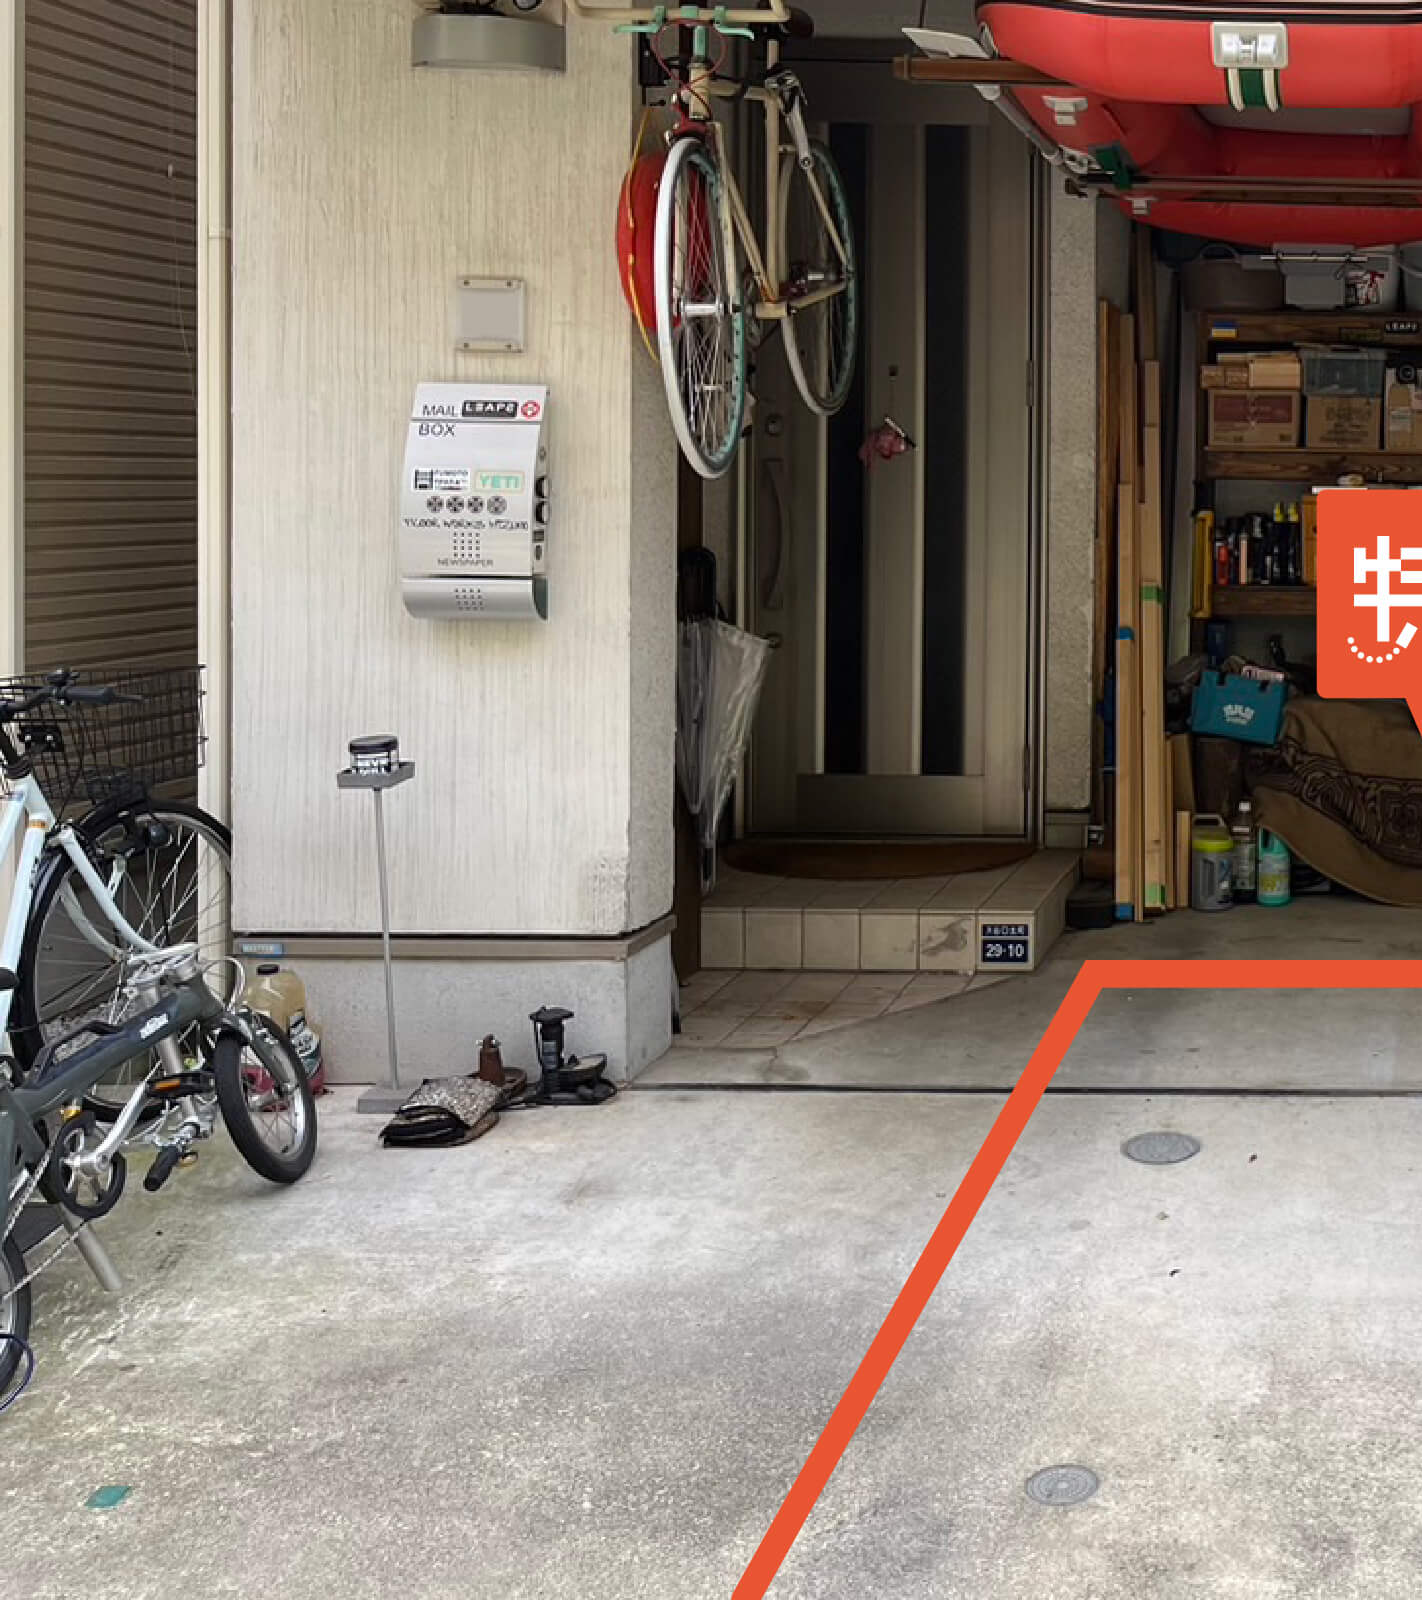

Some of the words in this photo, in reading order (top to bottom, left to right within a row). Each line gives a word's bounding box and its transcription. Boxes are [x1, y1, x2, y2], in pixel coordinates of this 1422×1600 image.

[422, 404, 459, 416] MAIL
[418, 423, 455, 436] BOX
[480, 474, 521, 489] YETI
[437, 558, 493, 567] NEWSPAPER
[985, 943, 1025, 957] 29-10
